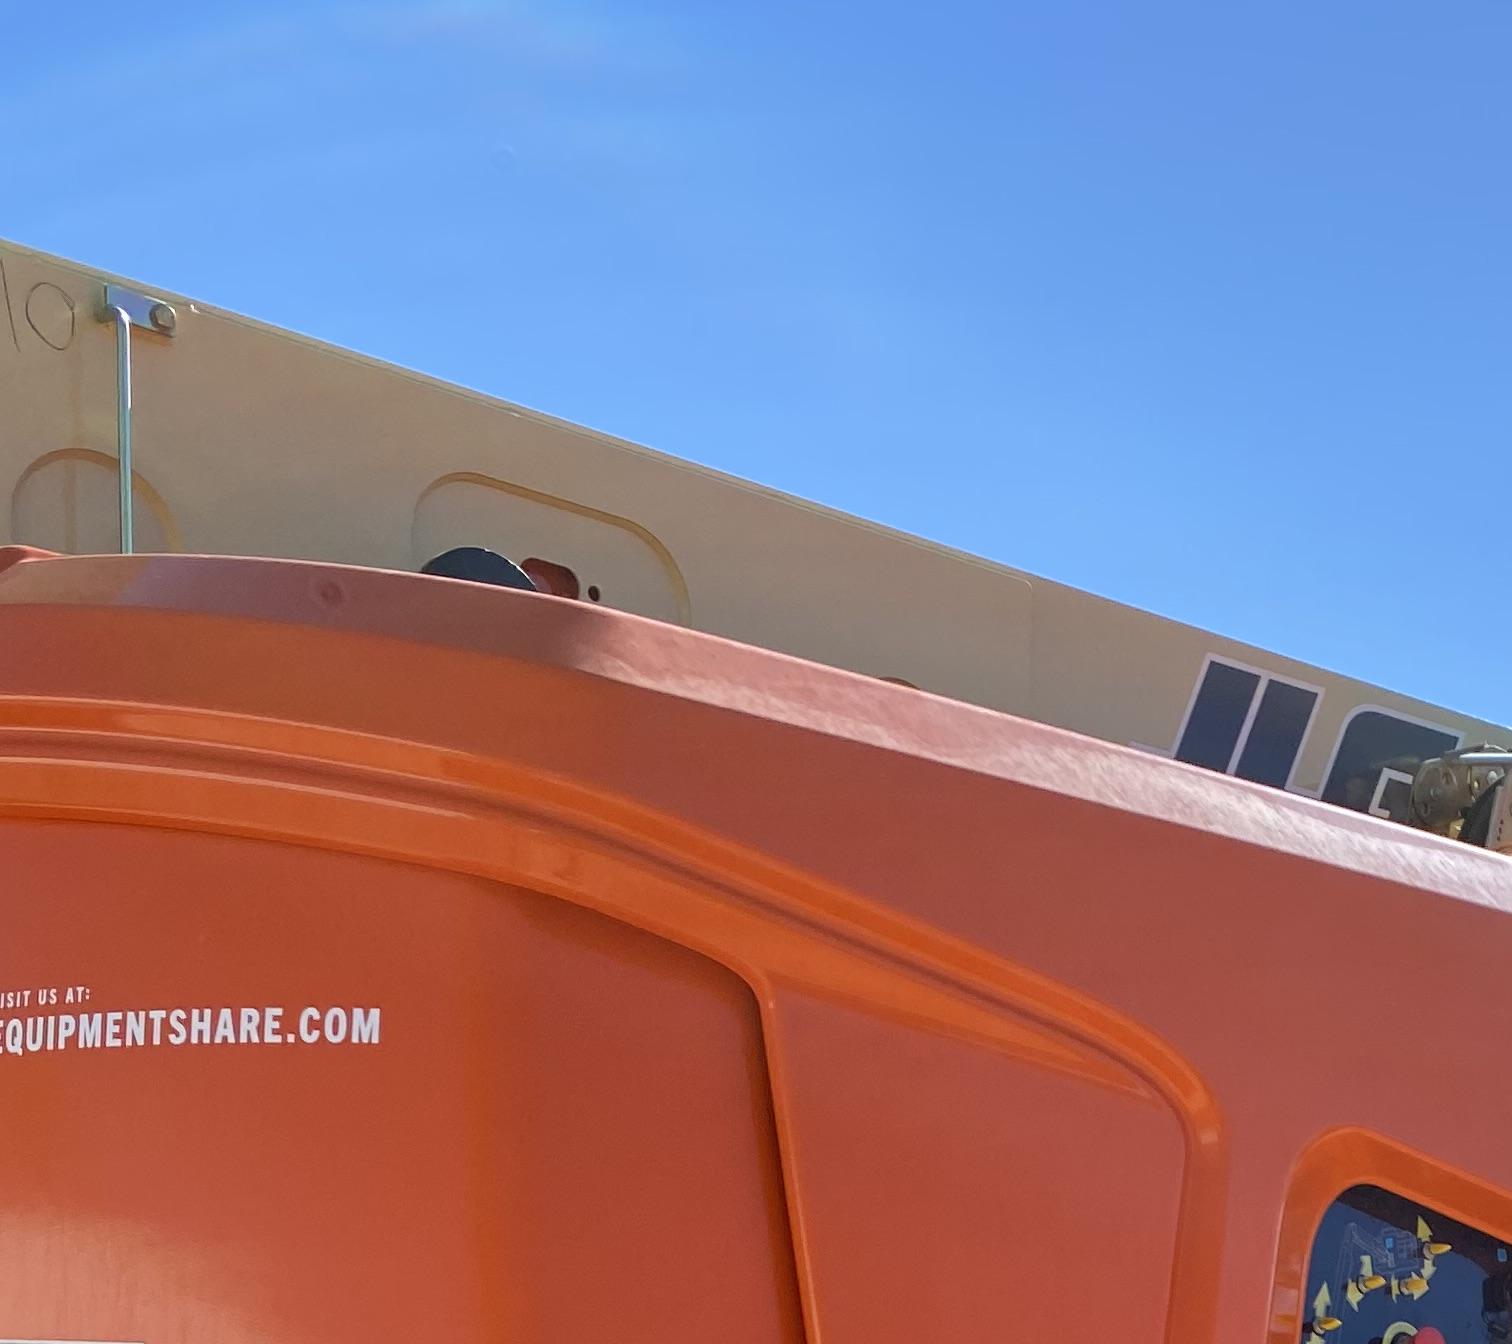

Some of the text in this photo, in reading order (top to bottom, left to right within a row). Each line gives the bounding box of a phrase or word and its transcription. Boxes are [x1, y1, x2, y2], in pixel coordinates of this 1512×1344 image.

[0, 986, 91, 1009] ISIT US AT:
[0, 1007, 381, 1056] QUIPMENTSHARE.COM
